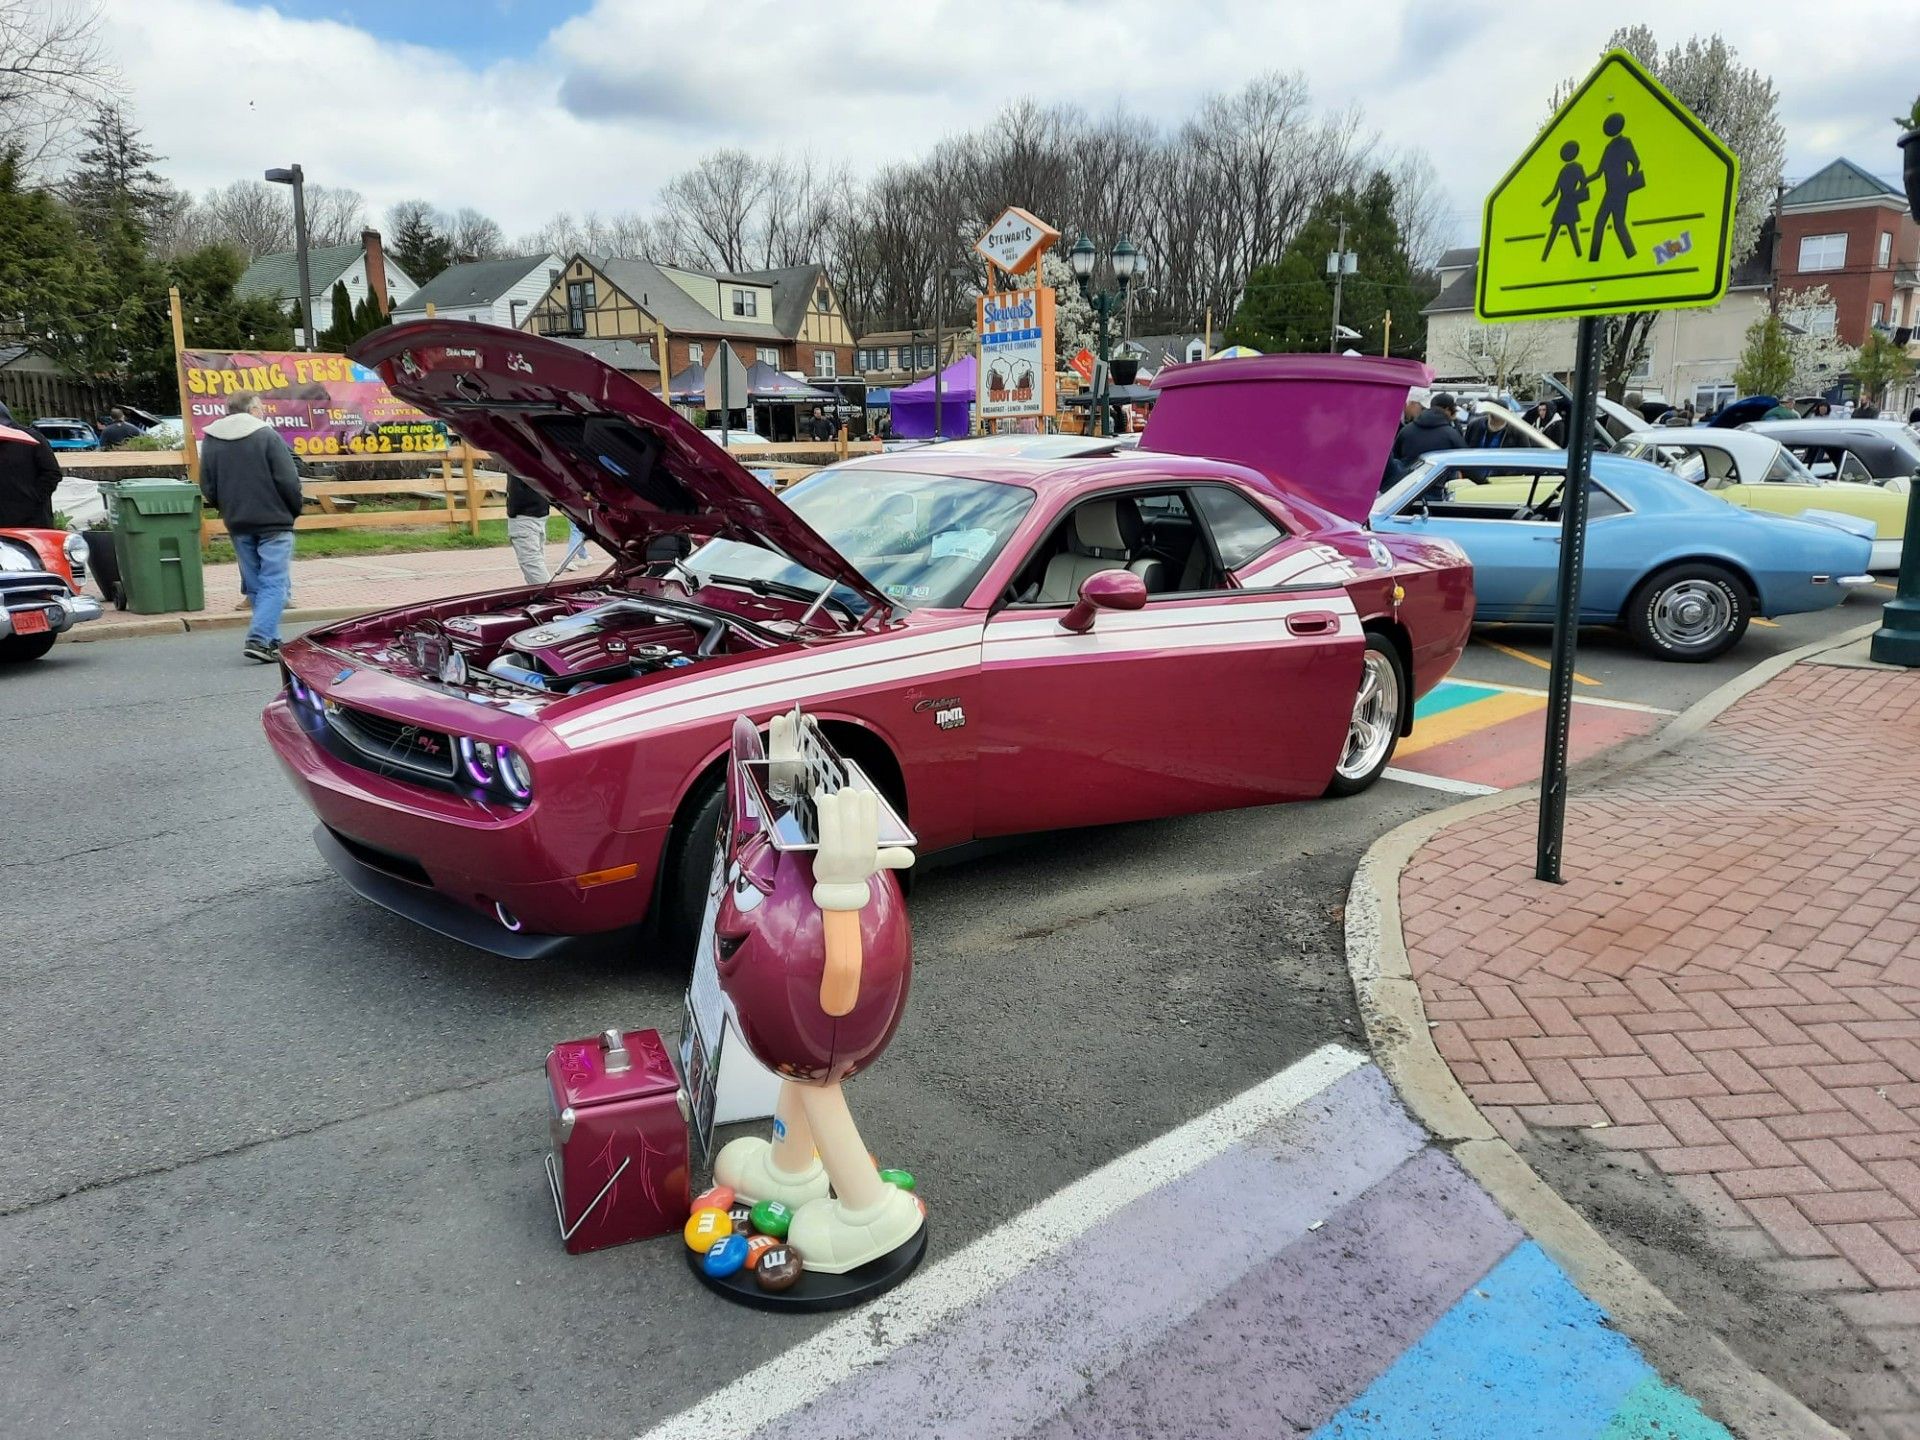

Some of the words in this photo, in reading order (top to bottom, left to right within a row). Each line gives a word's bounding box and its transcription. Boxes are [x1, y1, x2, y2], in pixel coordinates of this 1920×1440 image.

[985, 329, 1036, 343] DINER
[188, 363, 289, 396] SPRING
[989, 389, 1010, 402] ROOT
[1012, 387, 1032, 401] BEER
[192, 404, 226, 416] SUN
[265, 415, 308, 428] APRIL
[379, 426, 408, 434] MORE
[410, 425, 433, 433] INFO
[294, 433, 447, 455] 908-482-8132
